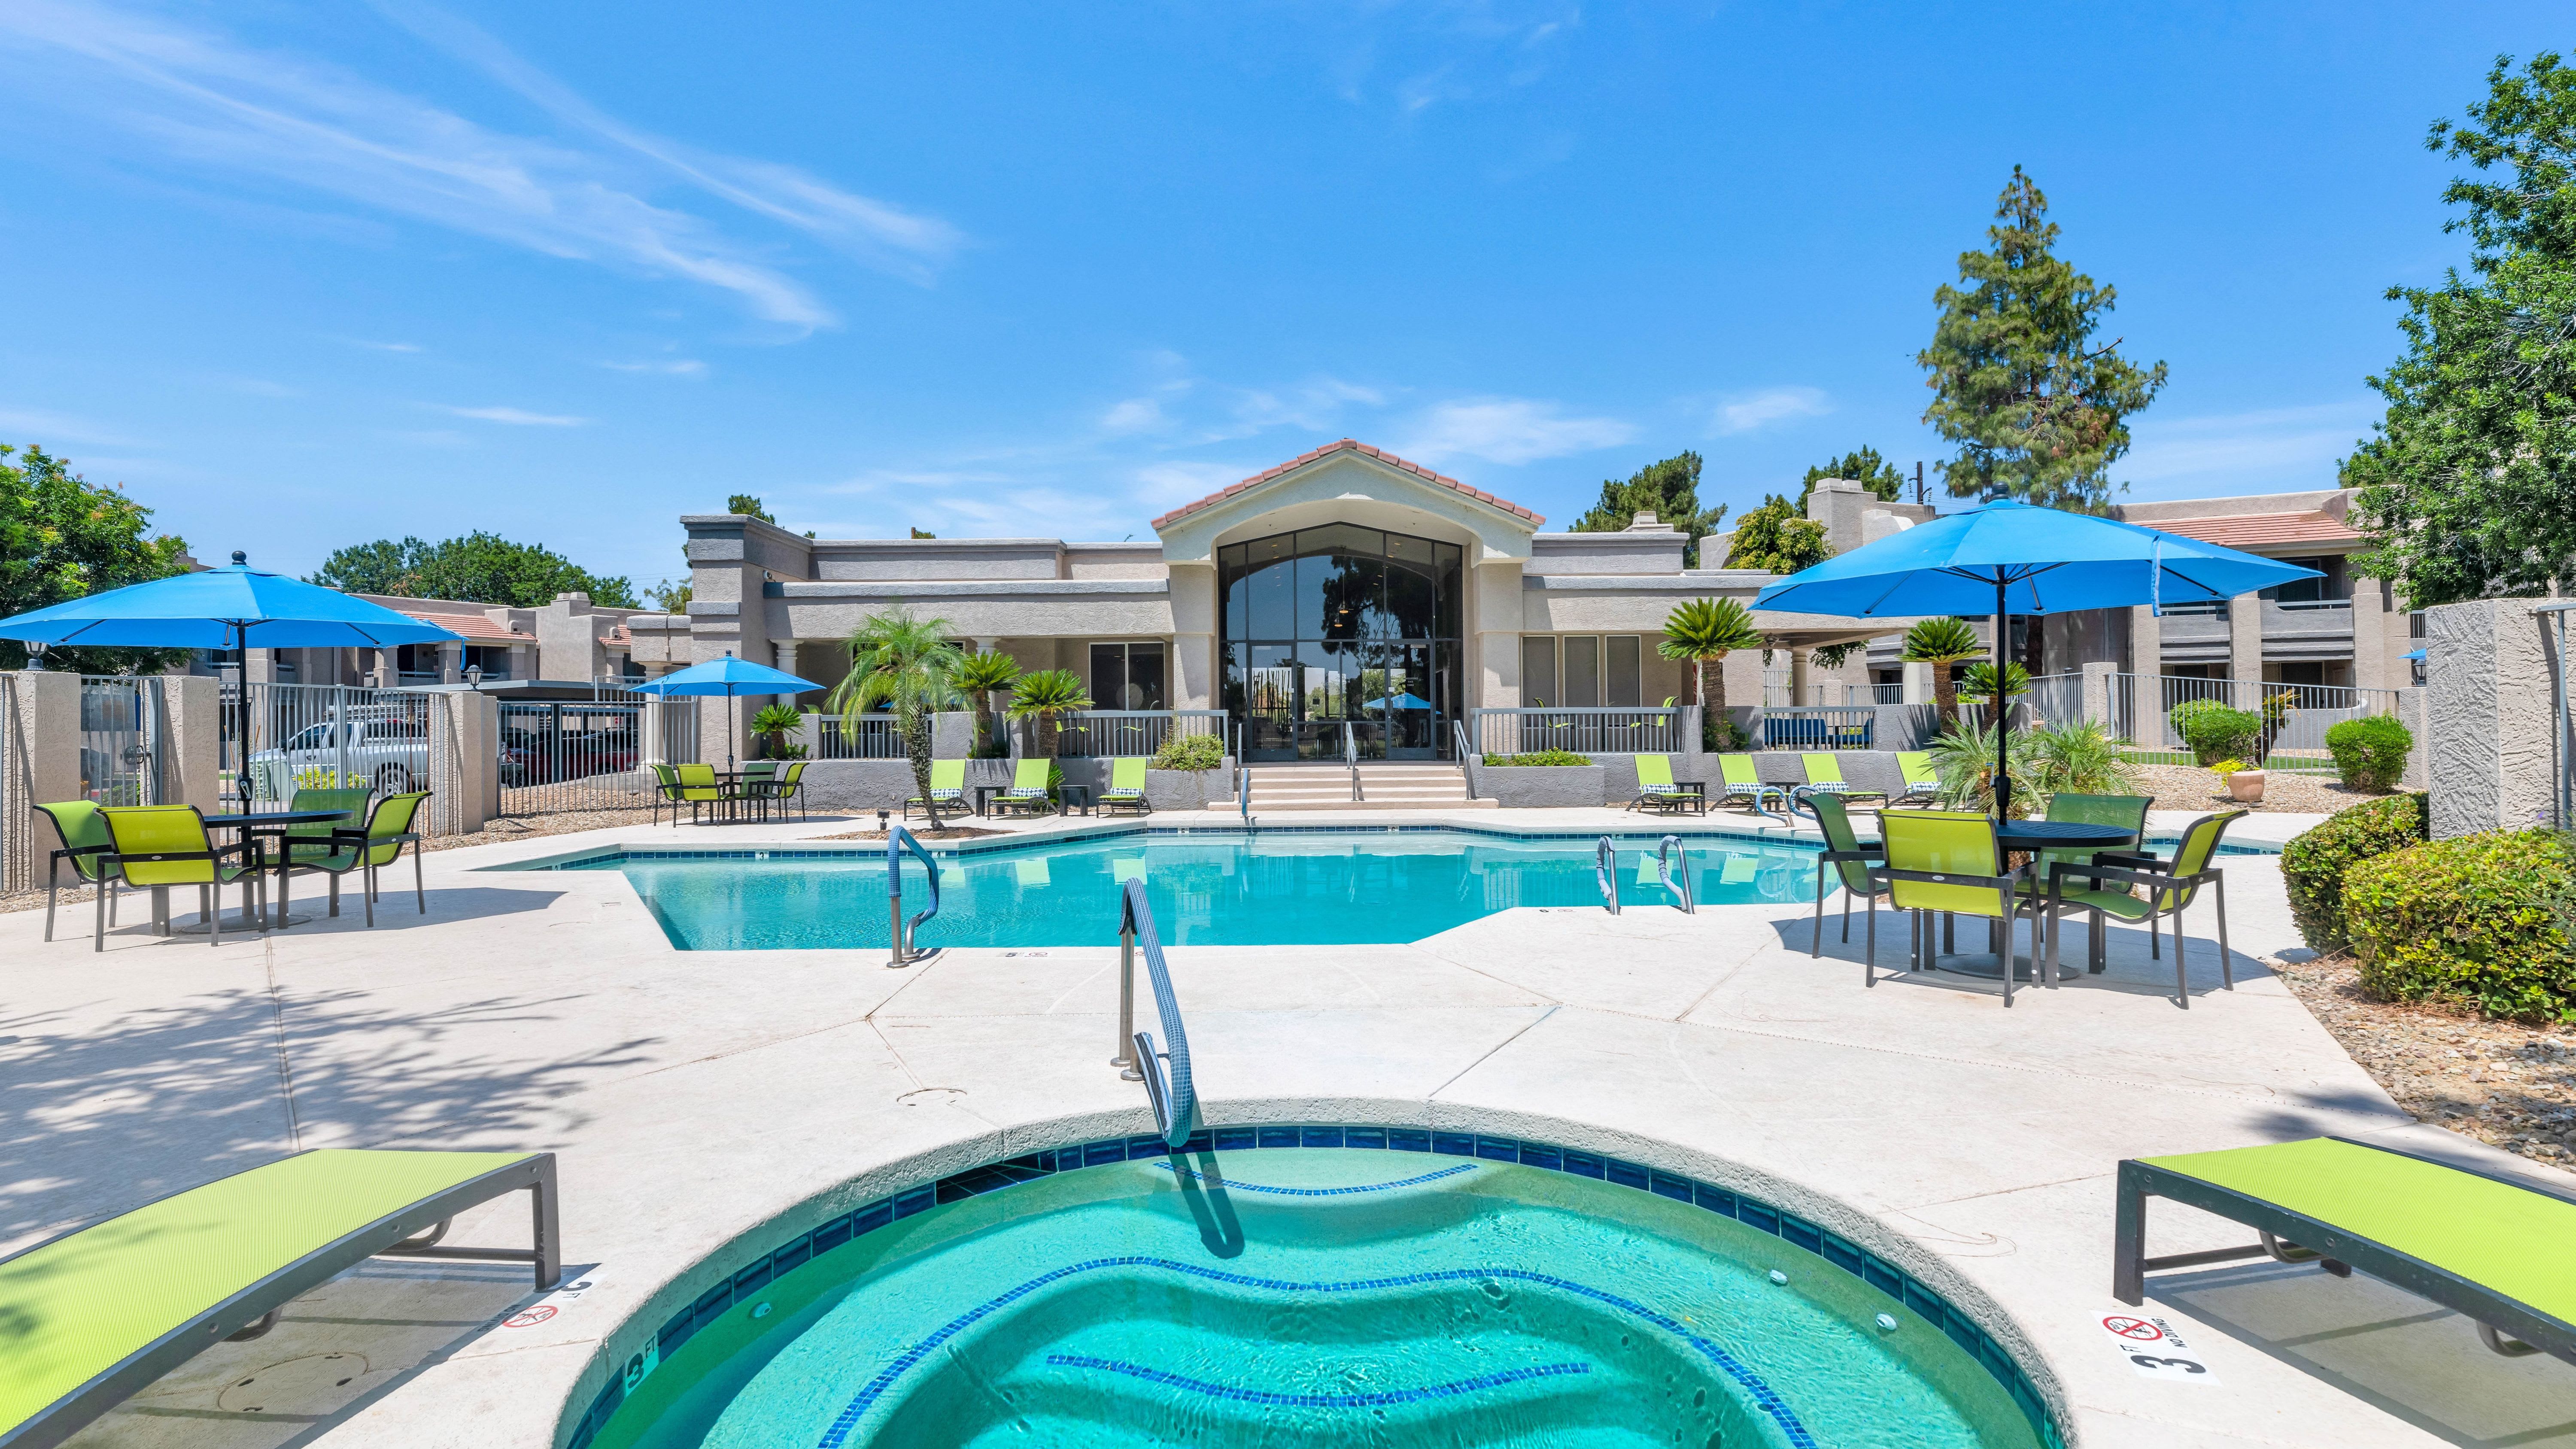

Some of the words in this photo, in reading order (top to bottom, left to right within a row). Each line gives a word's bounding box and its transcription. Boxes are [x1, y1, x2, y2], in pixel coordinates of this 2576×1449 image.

[477, 1313, 511, 1332] DIVING
[2151, 1318, 2179, 1338] DIVING
[2120, 1344, 2142, 1353] FT
[2169, 1339, 2188, 1348] NO
[627, 1353, 644, 1389] 3
[645, 1335, 656, 1358] FT
[2130, 1355, 2206, 1374] 3
